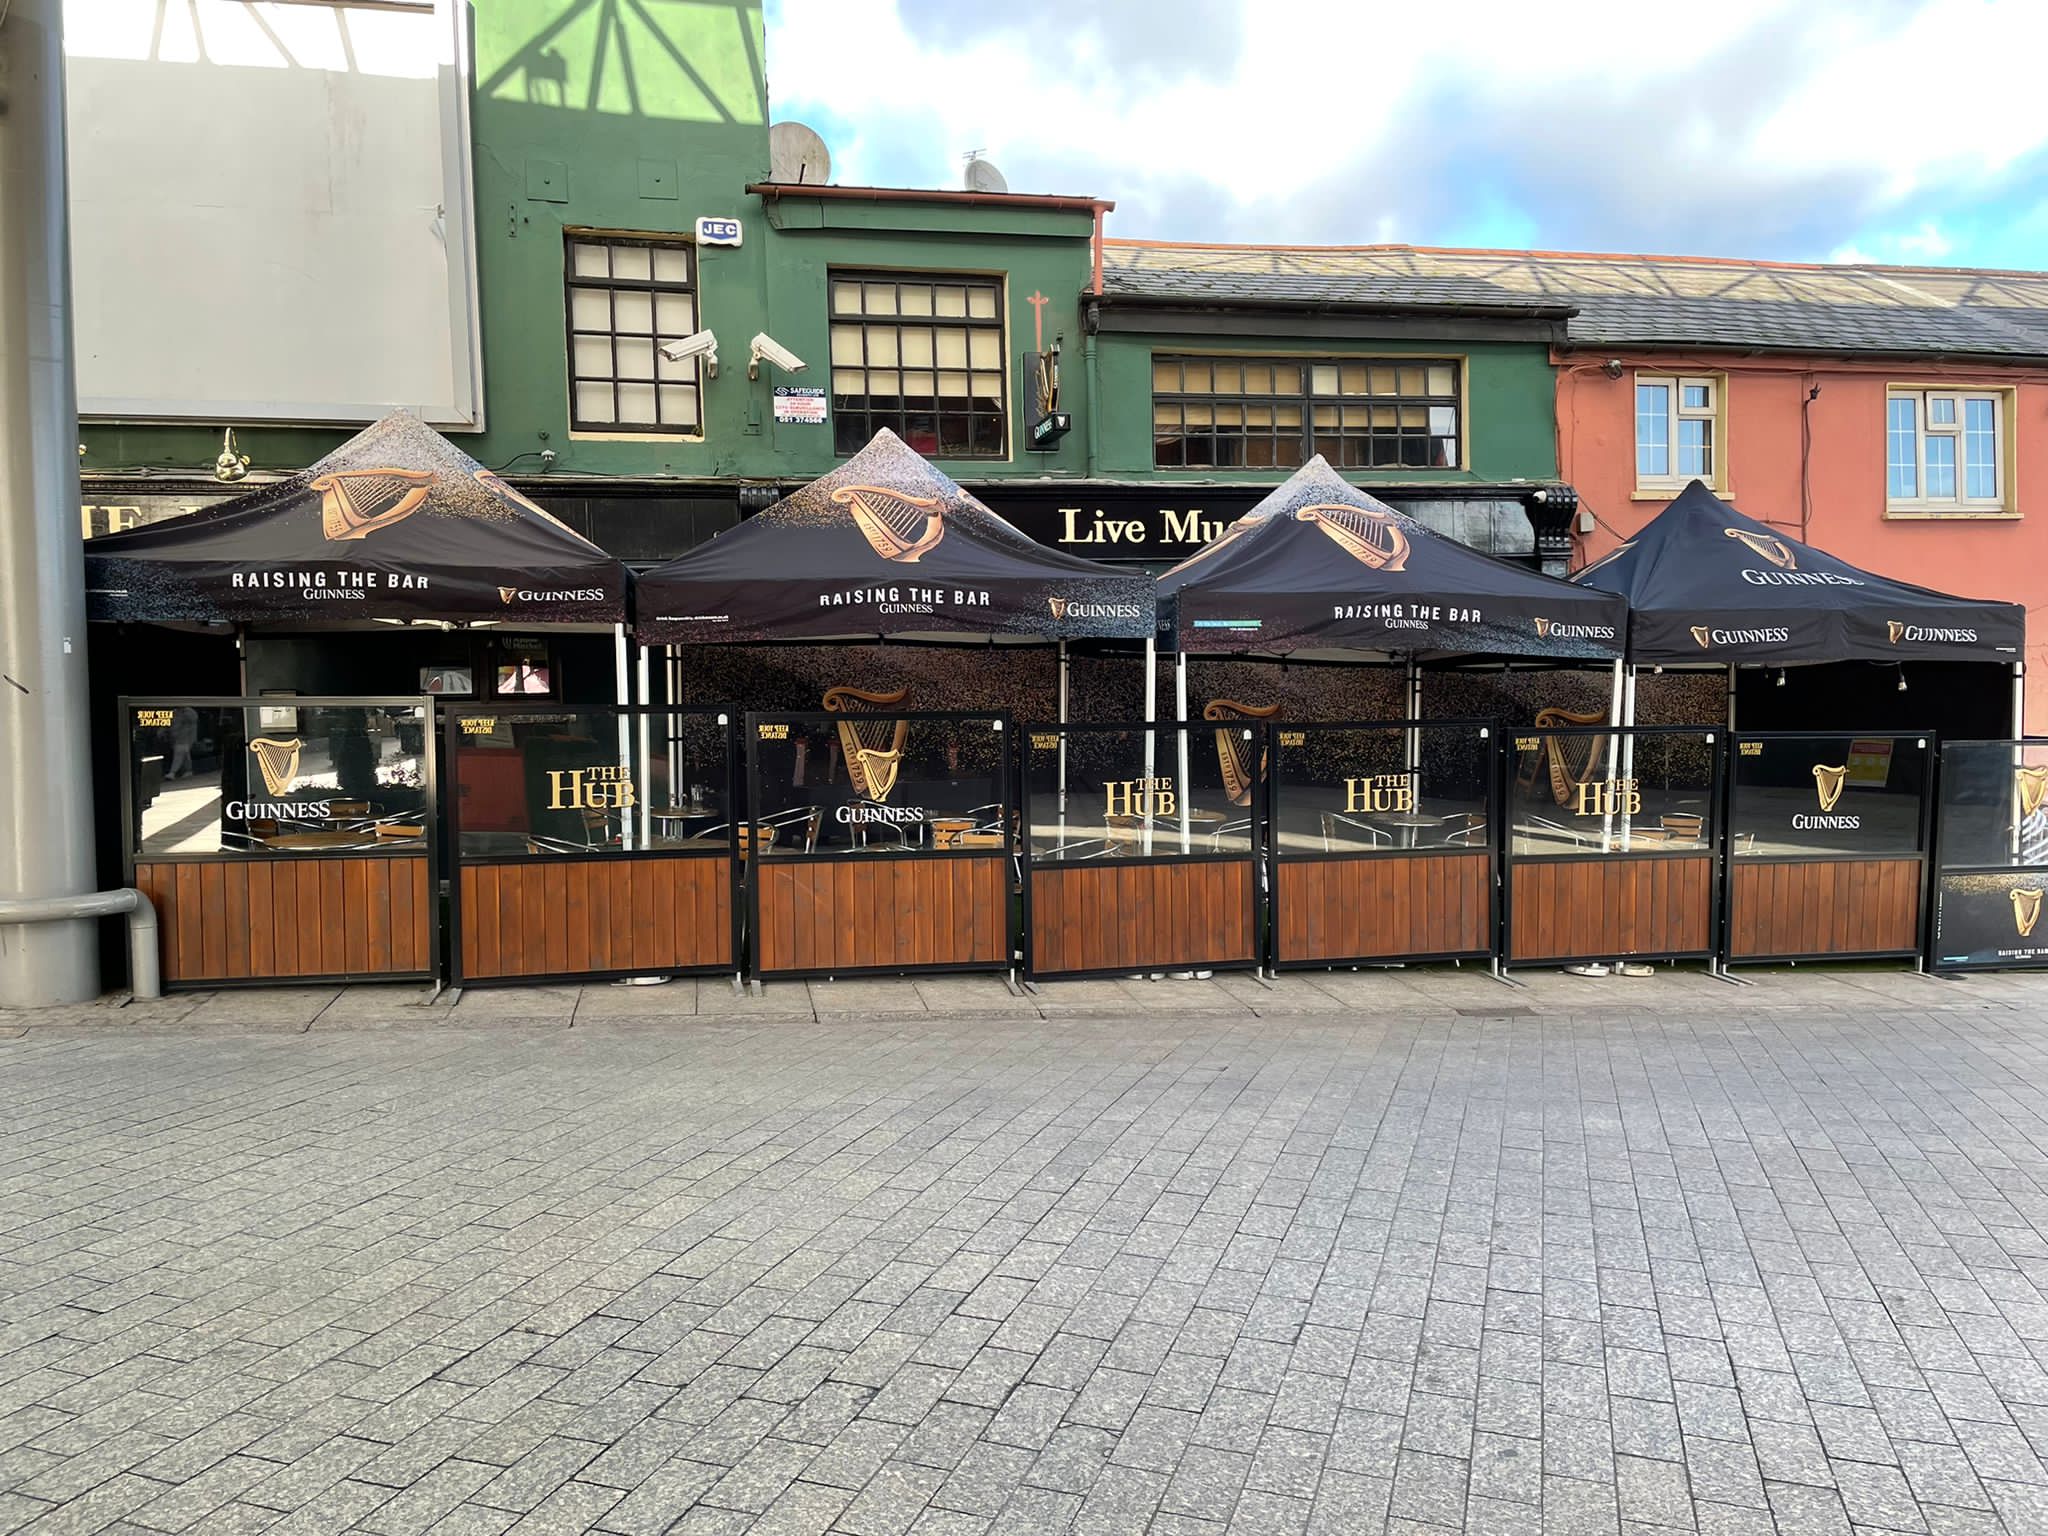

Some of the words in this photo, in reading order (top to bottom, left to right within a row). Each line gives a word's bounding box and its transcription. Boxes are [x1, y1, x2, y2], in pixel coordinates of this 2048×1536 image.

[704, 224, 736, 235] JEC
[1058, 508, 1146, 543] Live
[232, 572, 326, 588] RAISING
[337, 571, 377, 588] THE
[388, 574, 429, 589] BAR
[303, 588, 366, 600] GUINNESS
[518, 588, 604, 601] GUINNESS
[820, 587, 900, 606] RAISING
[908, 588, 944, 604] THE
[954, 590, 990, 606] BAR
[879, 602, 934, 614] GUINNESS
[1066, 602, 1140, 617] GUINNESS
[1334, 604, 1403, 620] RAISING
[1410, 604, 1441, 620] THE
[1449, 608, 1482, 623] BAR
[1384, 618, 1429, 630] GUINNESS
[1550, 622, 1615, 639] GUINNESS
[1712, 628, 1789, 644] GUINNESS
[1904, 626, 1978, 642] GUINNESS
[586, 766, 631, 780] THE
[1375, 774, 1410, 788] THE
[546, 770, 636, 809] HUB
[1135, 778, 1172, 790] THE
[1606, 778, 1639, 791] THE
[1102, 781, 1176, 816] HUB
[1344, 778, 1413, 812] HUB
[1576, 782, 1641, 816] HUB
[226, 801, 331, 820] GUINNESS
[835, 806, 924, 824] GUINNESS
[1792, 814, 1860, 829] GUINNESS
